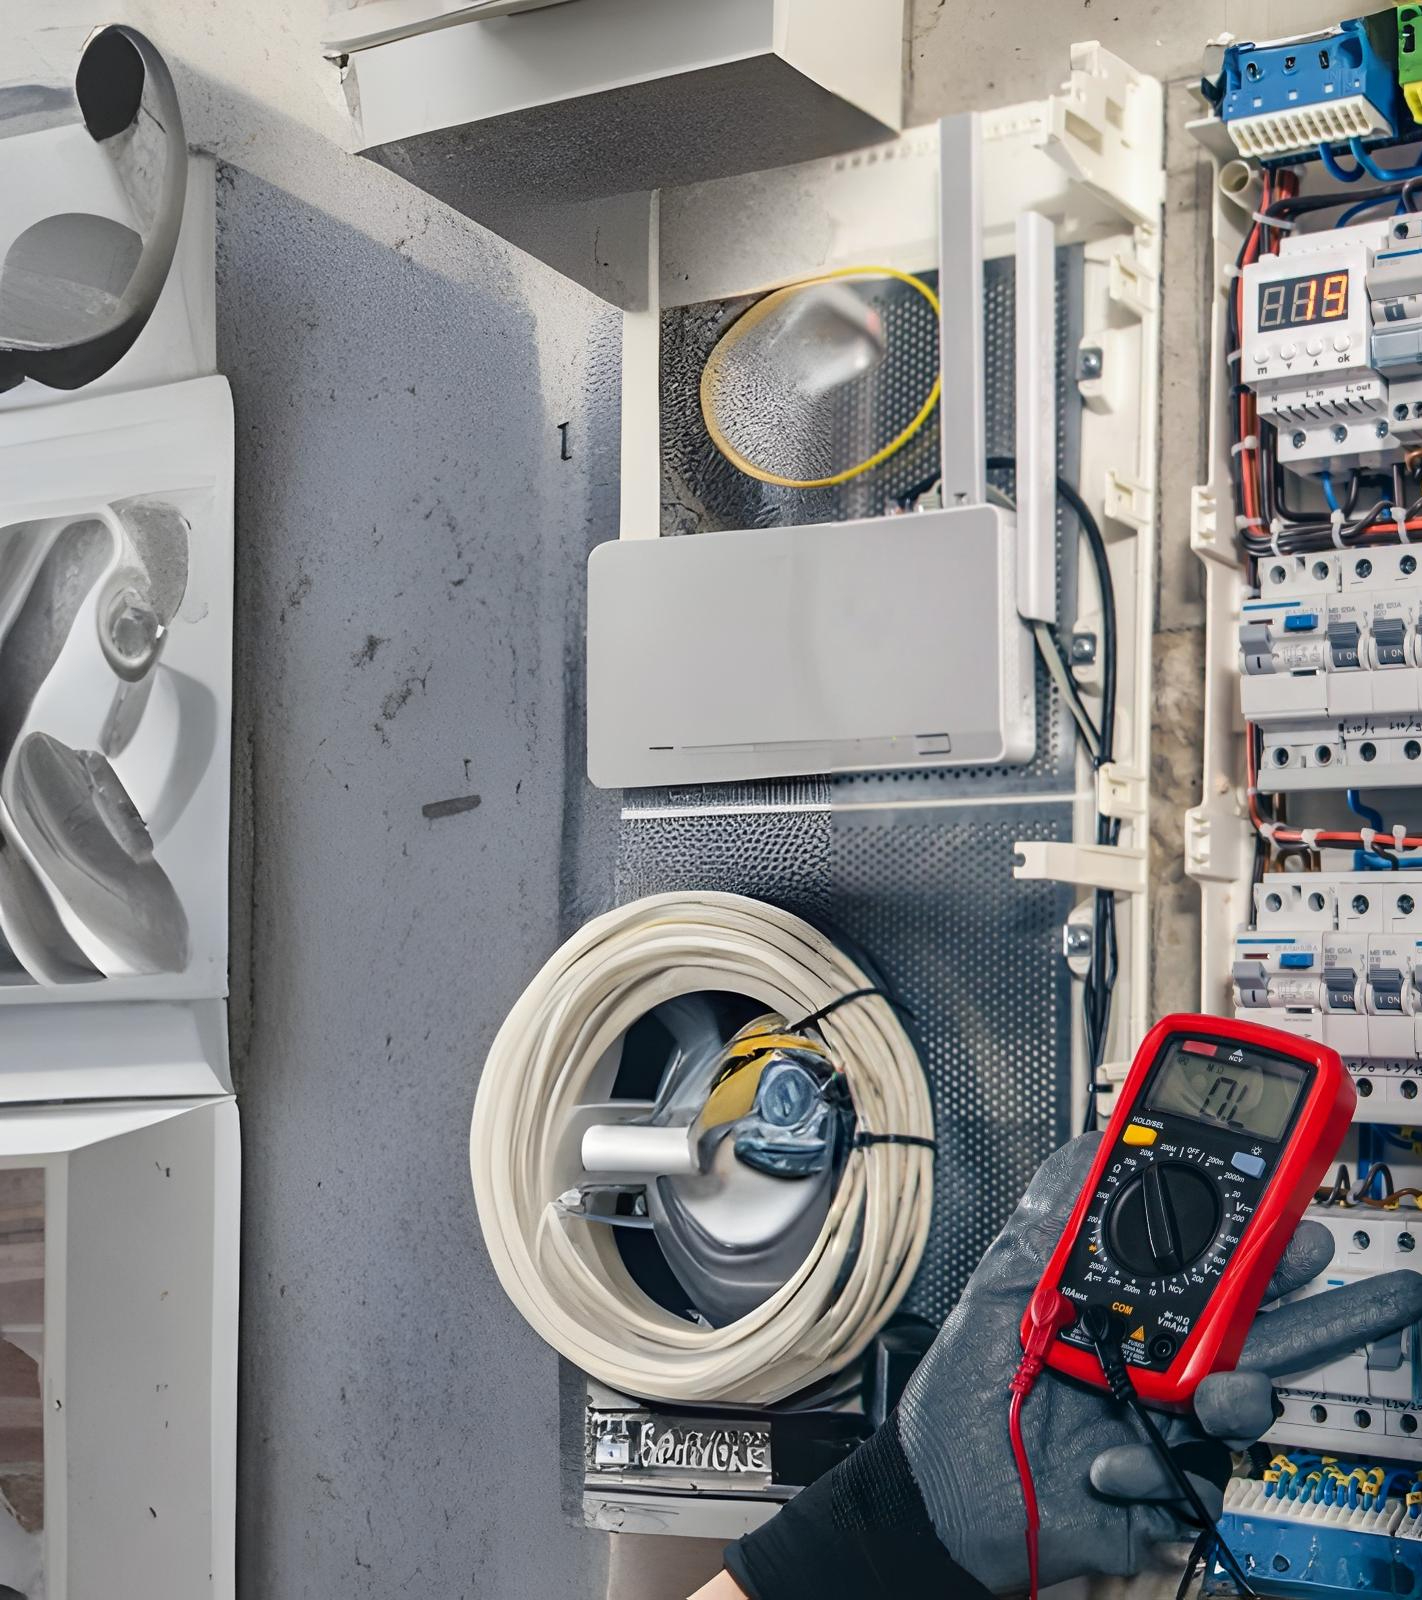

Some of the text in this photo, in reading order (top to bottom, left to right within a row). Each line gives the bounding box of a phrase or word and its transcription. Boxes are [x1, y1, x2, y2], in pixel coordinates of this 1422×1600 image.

[1338, 354, 1350, 363] ok
[1356, 383, 1371, 391] out
[1228, 1055, 1244, 1063] NCV
[1133, 1116, 1164, 1129] HOLD/SEL
[1160, 1143, 1177, 1153] 200M
[1187, 1147, 1201, 1155] OFF
[1140, 1149, 1154, 1158] 20M
[1207, 1156, 1225, 1166] 200m
[1224, 1172, 1245, 1183] 2000m
[1087, 1216, 1099, 1224] 200
[1231, 1214, 1245, 1223] 200
[1225, 1235, 1239, 1244] 600
[1213, 1256, 1226, 1265] 600
[1108, 1276, 1121, 1286] 20m
[1191, 1274, 1205, 1284] 200
[1123, 1284, 1141, 1295] 200m
[1149, 1288, 1157, 1296] 10
[1168, 1284, 1184, 1295] NCV
[1112, 1302, 1134, 1315] COM
